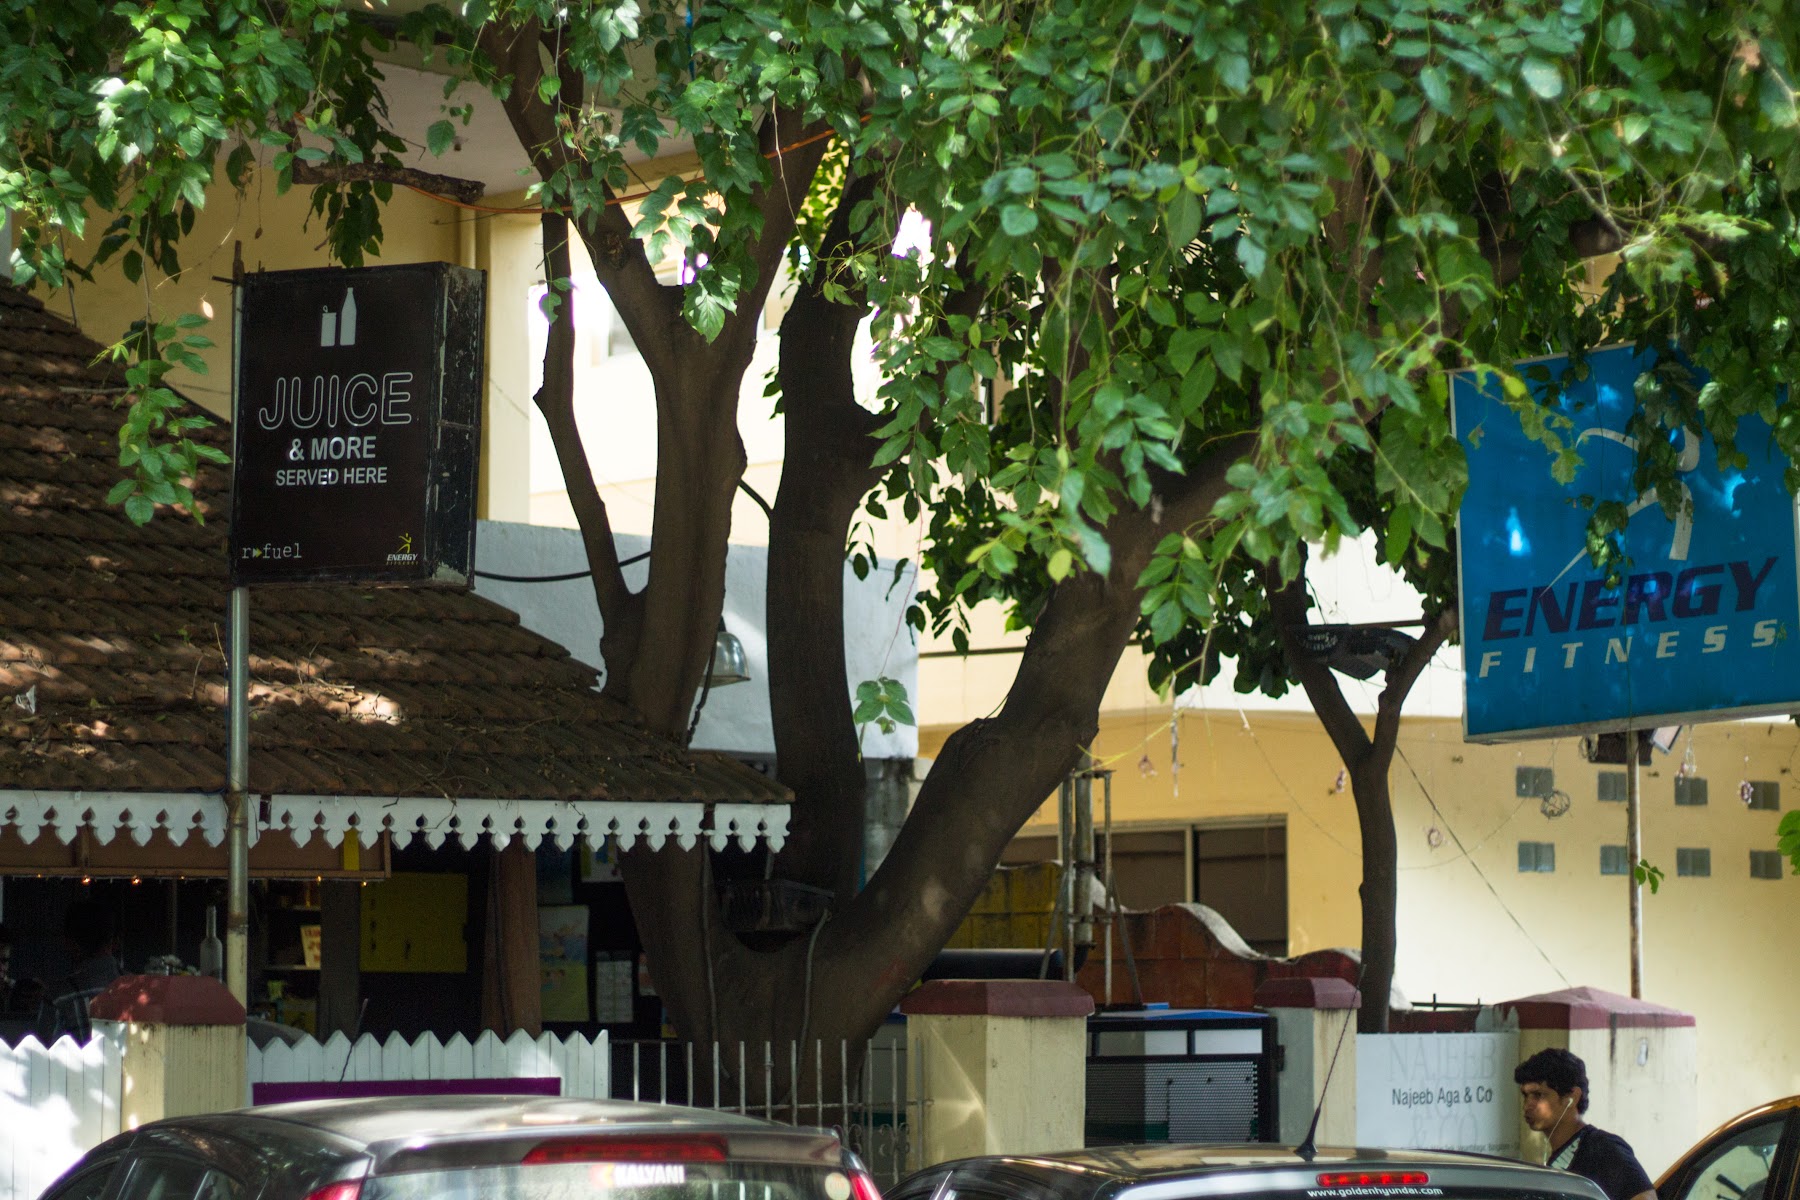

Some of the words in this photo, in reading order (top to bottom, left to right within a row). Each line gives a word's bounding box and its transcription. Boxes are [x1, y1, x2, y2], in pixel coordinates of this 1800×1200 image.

[258, 371, 414, 431] JUICE
[288, 437, 305, 461] &
[310, 436, 377, 460] MORE
[275, 468, 339, 486] SERVED
[343, 467, 388, 484] HERE
[387, 553, 418, 561] ENERGY
[1482, 556, 1779, 642] ENERGY
[1479, 619, 1778, 679] FITNESS
[1391, 1088, 1434, 1109] Najeeb
[1437, 1086, 1460, 1108] Aga
[1463, 1086, 1473, 1104] &
[1476, 1085, 1494, 1103] Co
[615, 1163, 685, 1187] KALYANI
[1307, 1186, 1444, 1198] www.goldenhyundai.com
